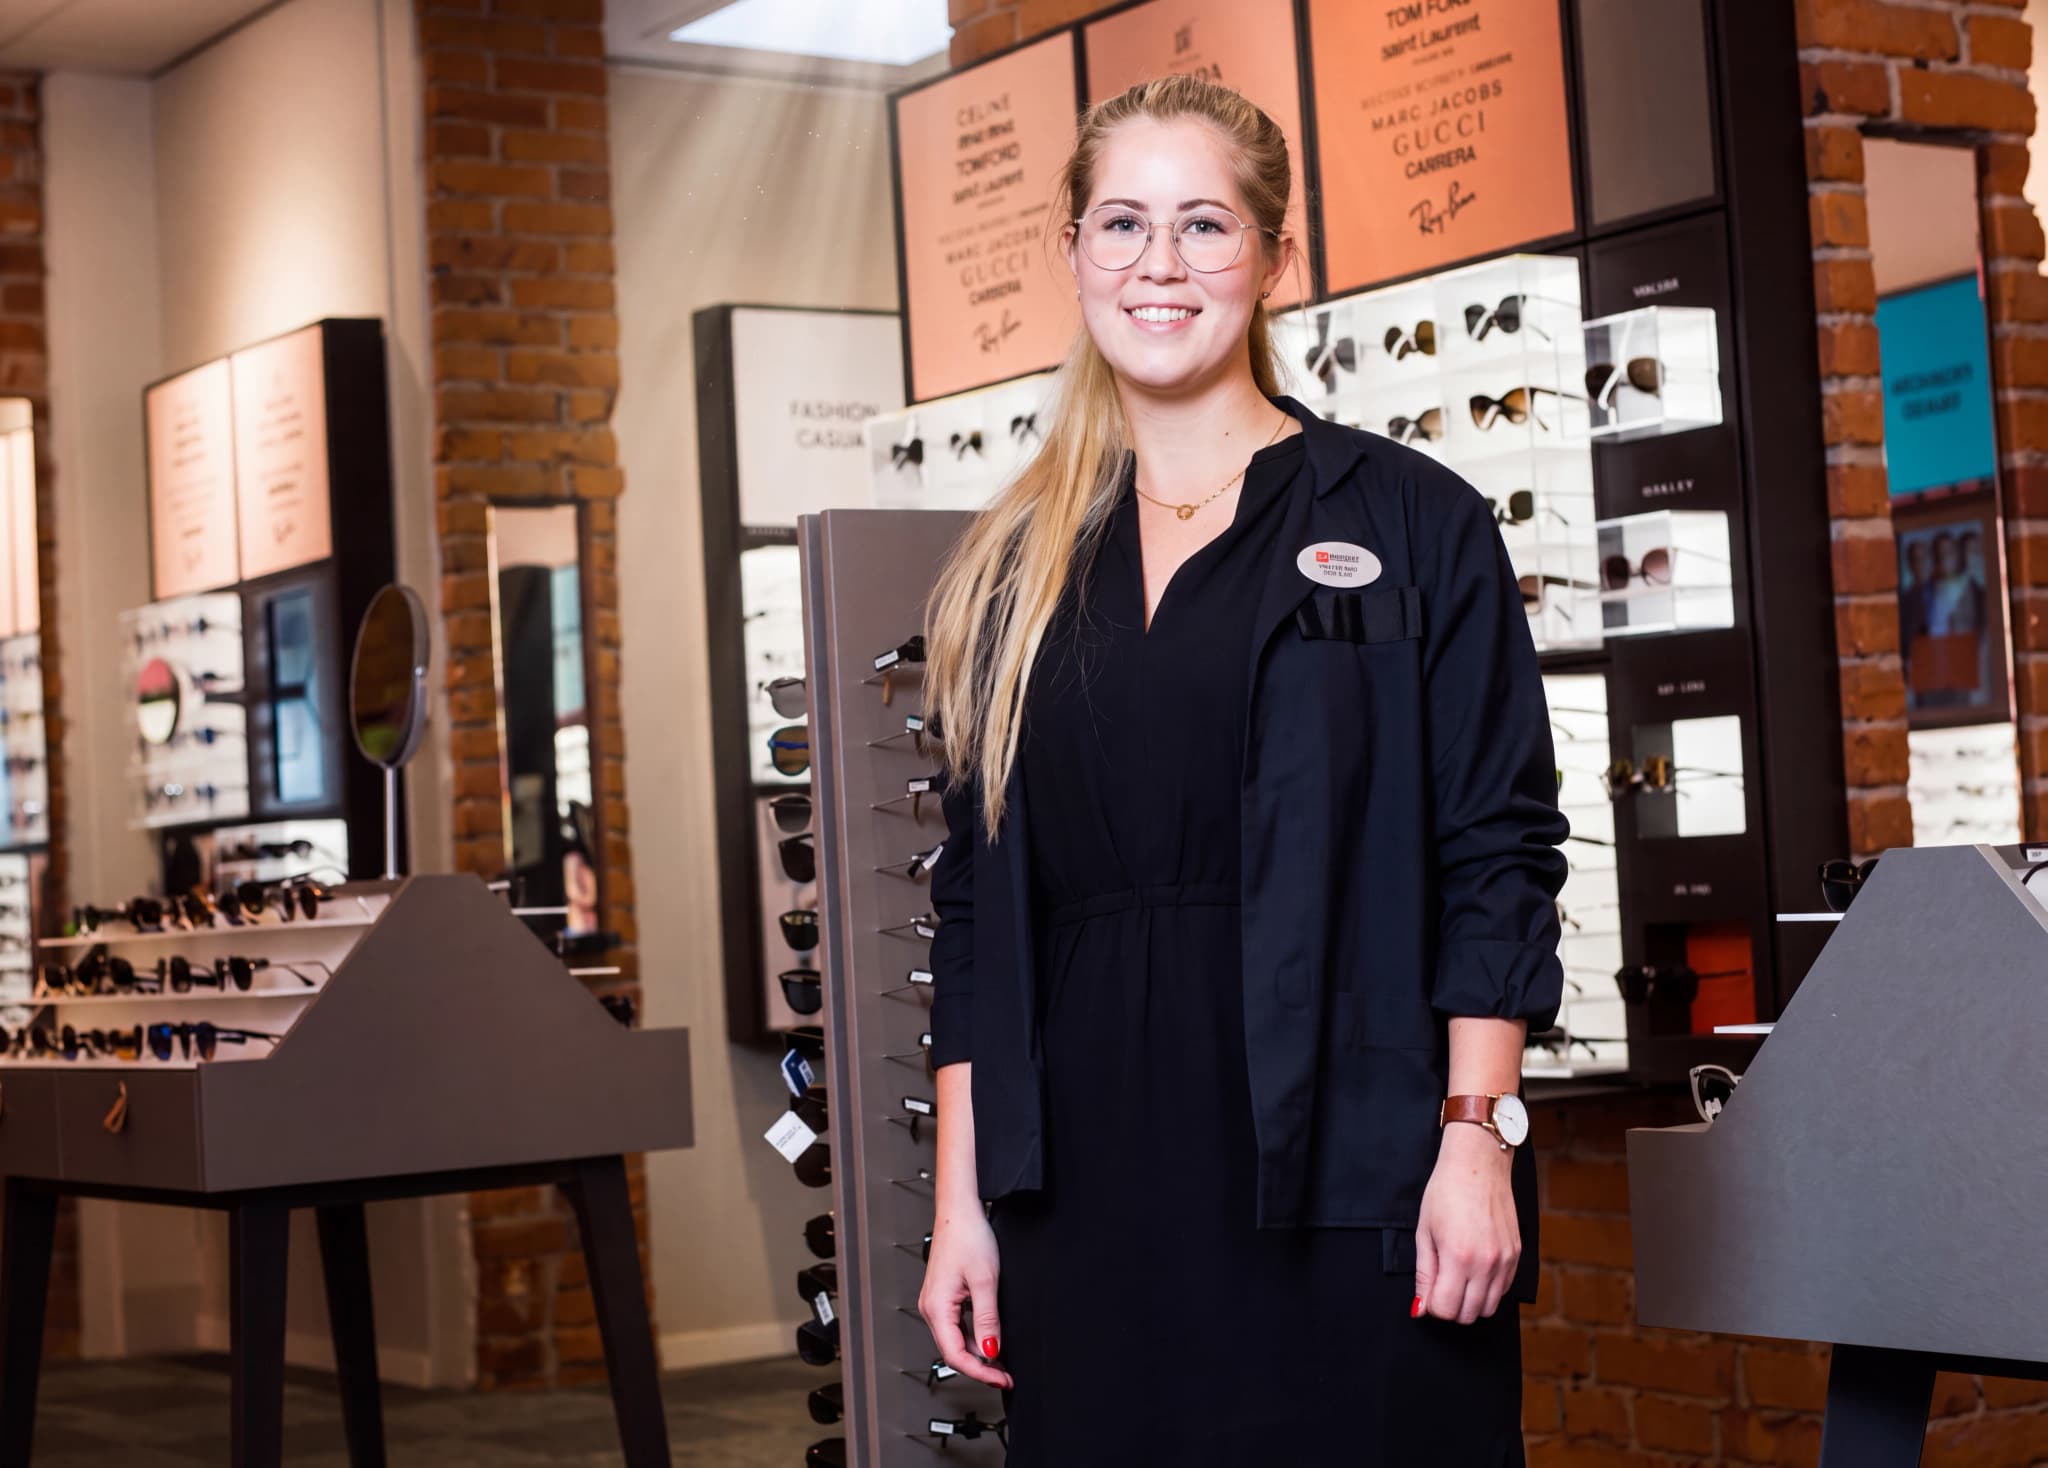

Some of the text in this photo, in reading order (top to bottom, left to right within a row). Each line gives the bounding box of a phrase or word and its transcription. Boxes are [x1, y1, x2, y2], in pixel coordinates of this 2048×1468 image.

[1386, 0, 1471, 30] TOM FO
[1420, 12, 1480, 48] Laurent
[1371, 104, 1421, 132] MARC
[1430, 78, 1503, 117] JACOBS
[1392, 109, 1485, 157] GUCCI
[1405, 145, 1476, 179] CARRERA
[959, 248, 1029, 289] GUCCI
